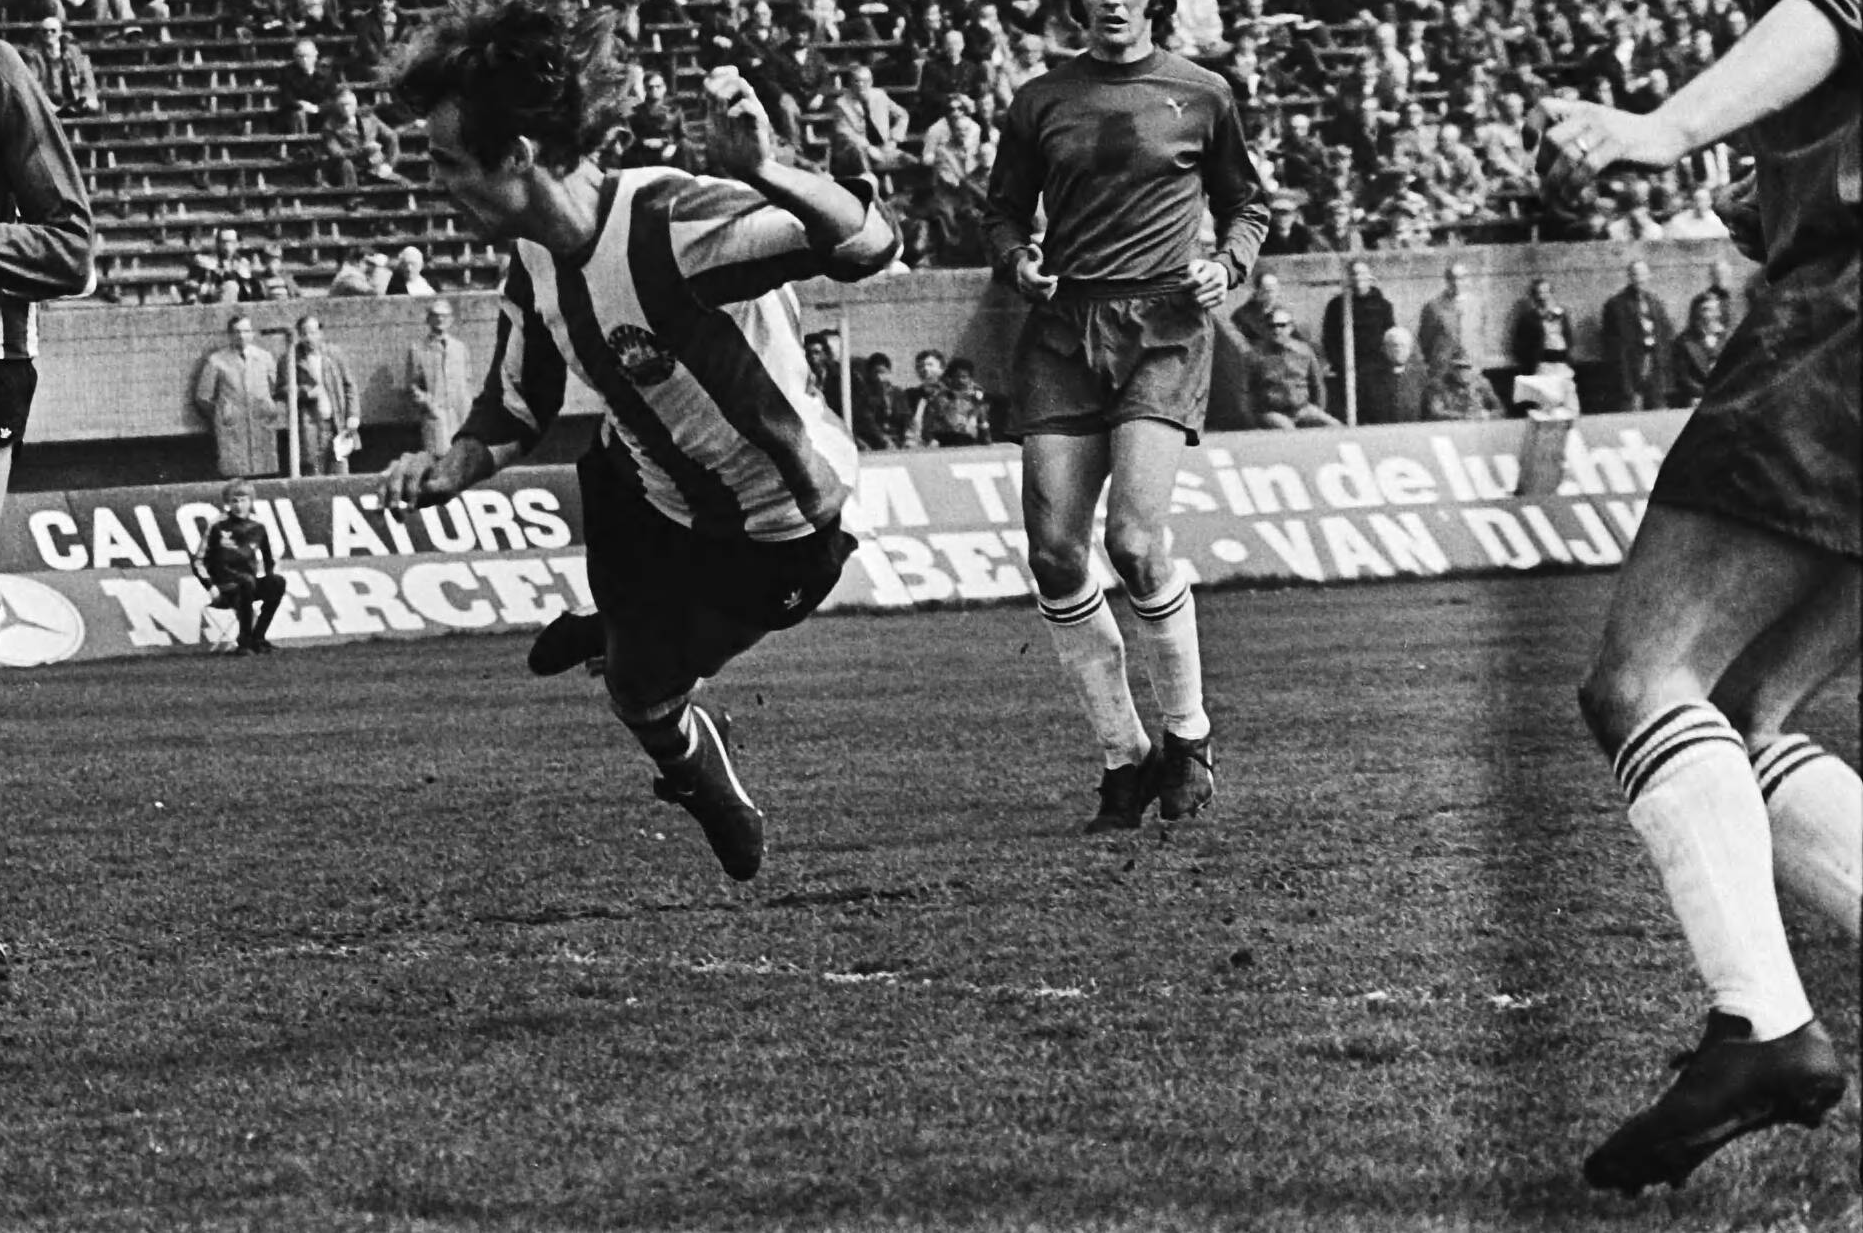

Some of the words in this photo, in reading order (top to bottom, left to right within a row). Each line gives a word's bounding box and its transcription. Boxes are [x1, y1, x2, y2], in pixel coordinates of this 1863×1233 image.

[1208, 448, 1314, 517] in
[1316, 440, 1440, 508] de
[1430, 427, 1664, 502] luht
[1254, 512, 1451, 581] VAN
